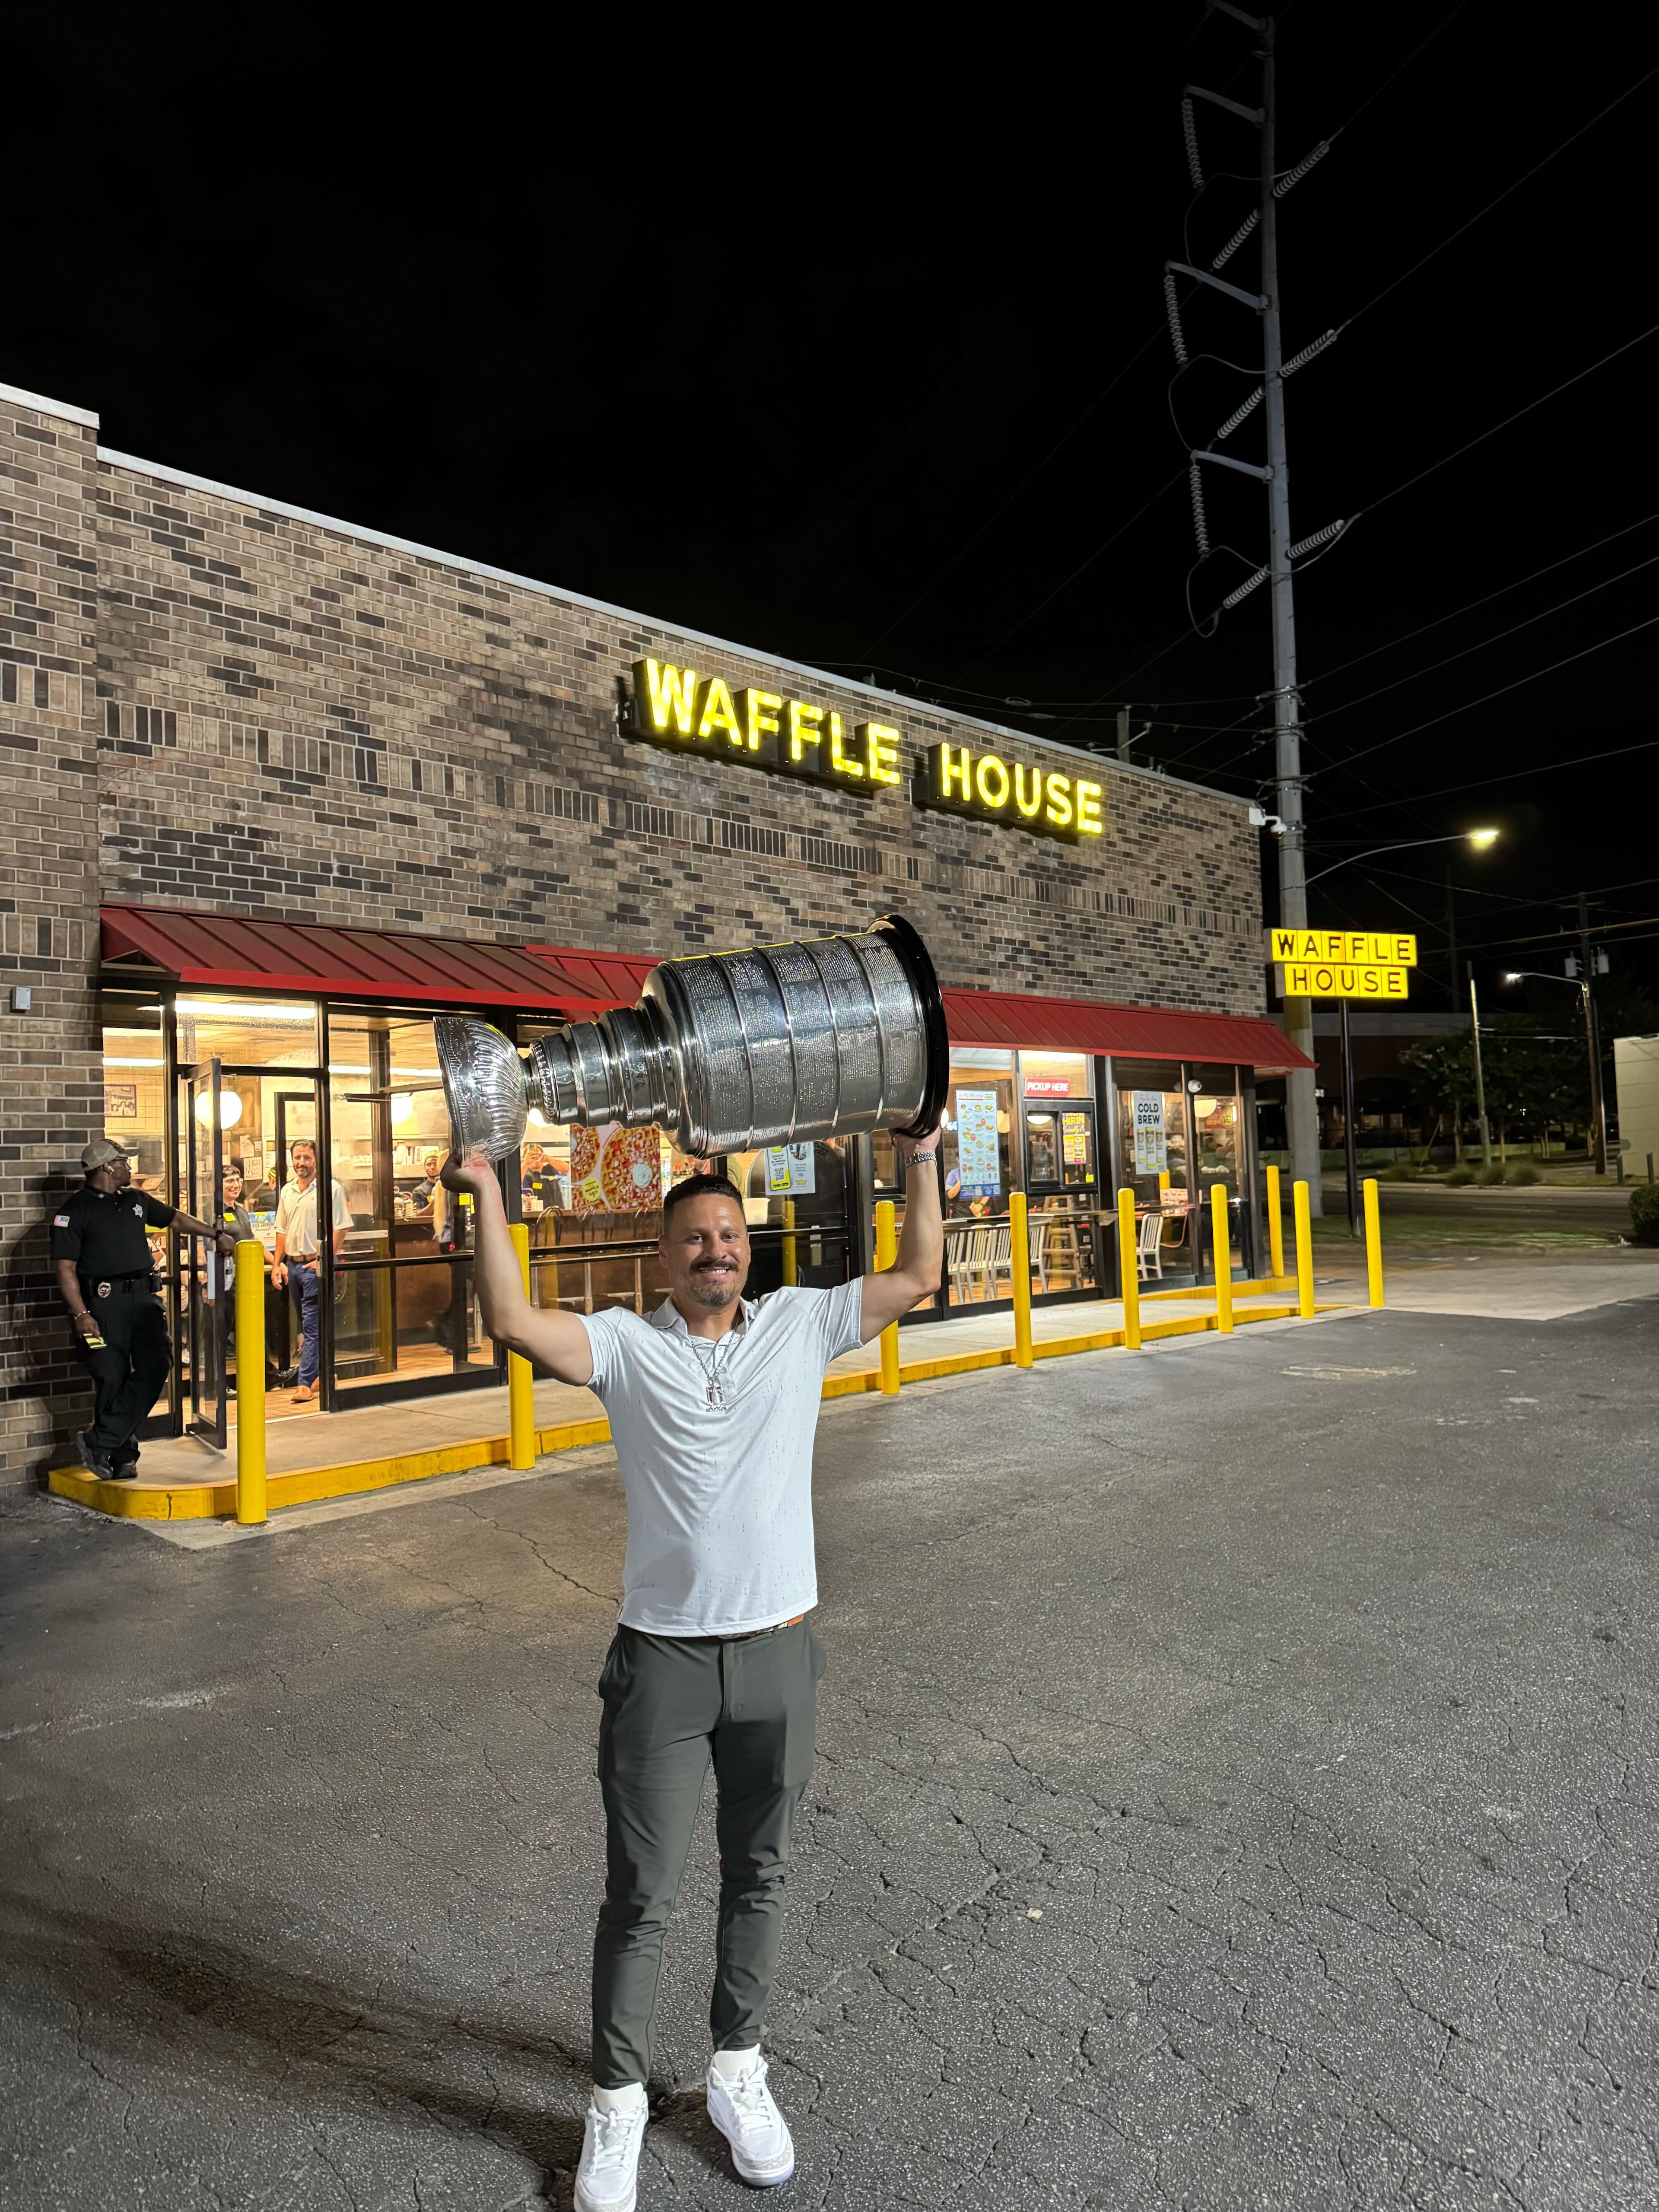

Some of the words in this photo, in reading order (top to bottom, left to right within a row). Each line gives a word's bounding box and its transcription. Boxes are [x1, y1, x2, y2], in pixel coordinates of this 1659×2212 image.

[645, 657, 901, 785] WAFFLE
[941, 742, 1103, 834] HOUSE
[1277, 933, 1411, 960] WAFFLE
[1293, 969, 1402, 992] HOUSE
[1027, 1081, 1052, 1091] PICKUP
[1051, 1082, 1069, 1092] HERE
[1138, 1103, 1159, 1113] COLD
[1062, 1116, 1085, 1125] HIRIN
[1138, 1115, 1160, 1124] BREW
